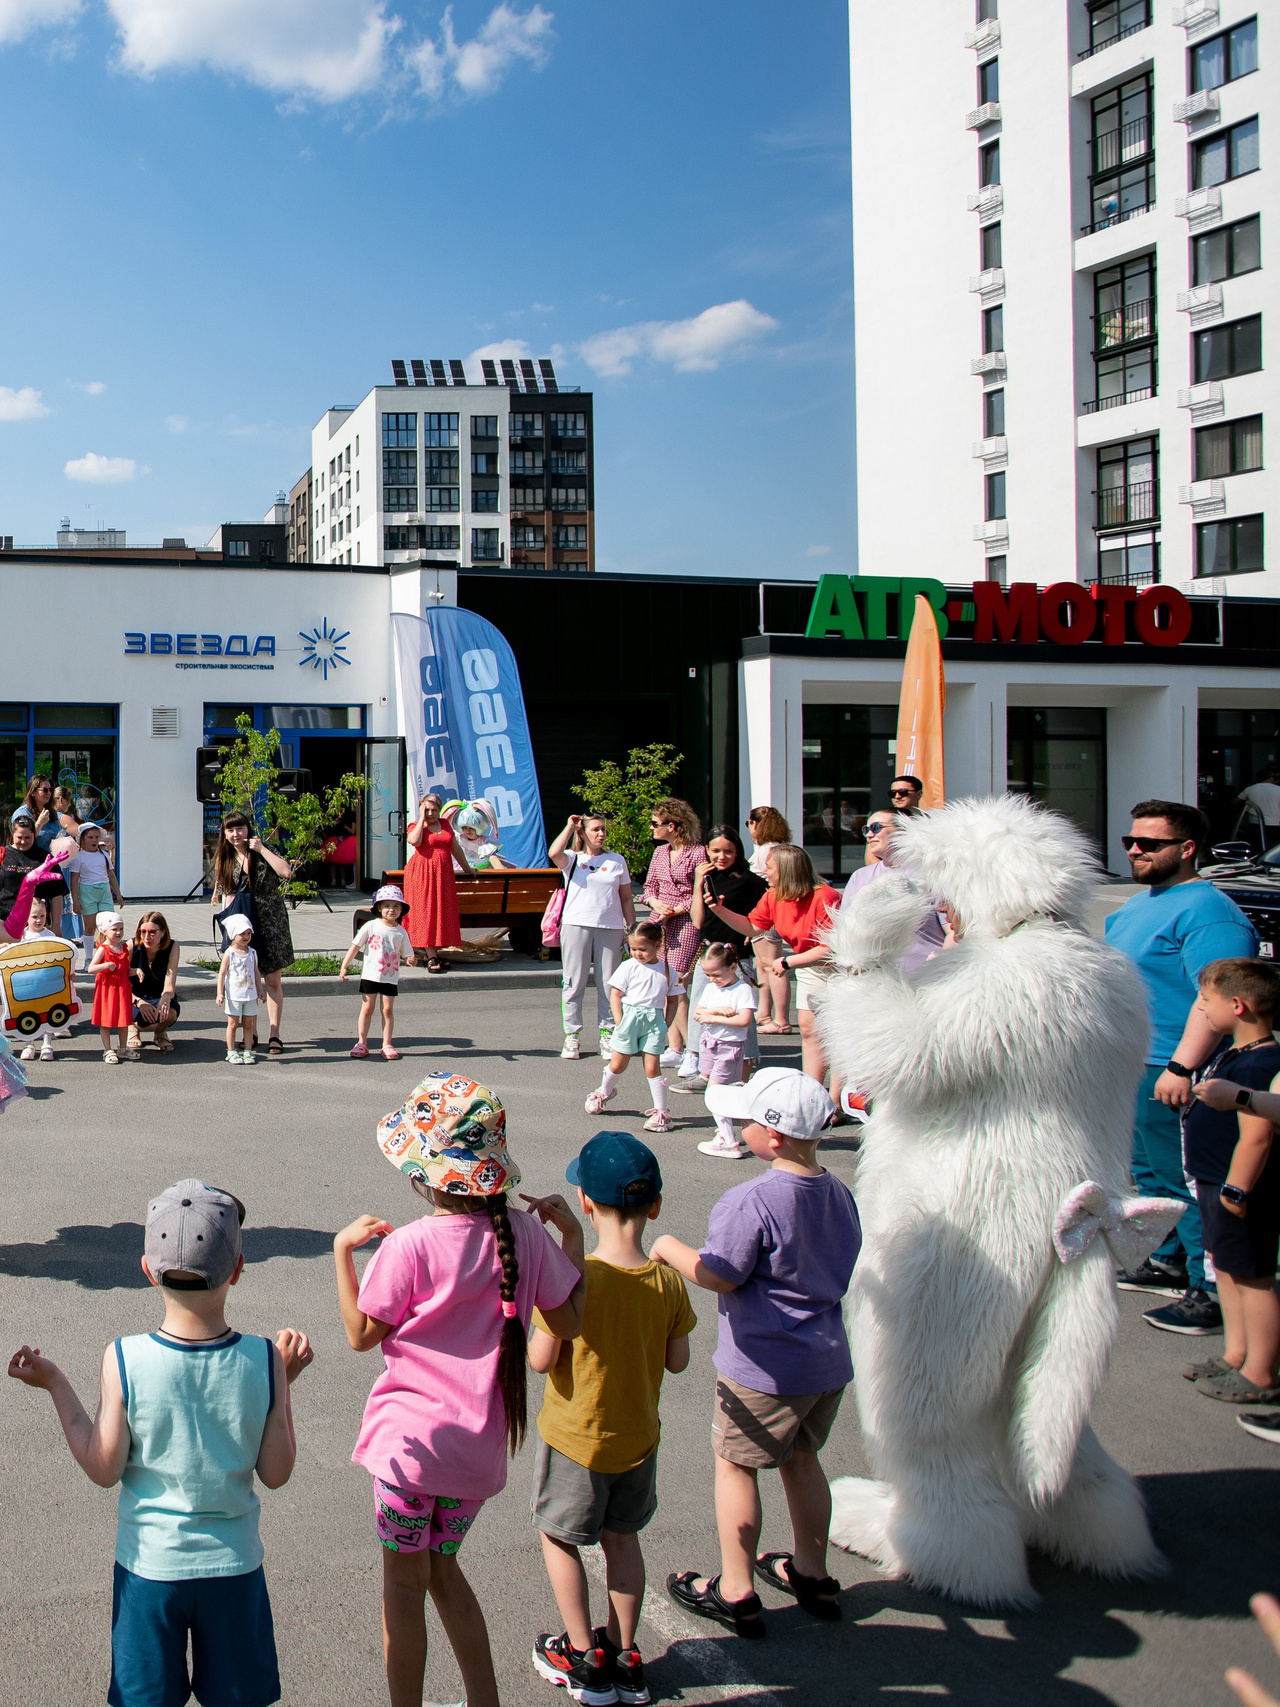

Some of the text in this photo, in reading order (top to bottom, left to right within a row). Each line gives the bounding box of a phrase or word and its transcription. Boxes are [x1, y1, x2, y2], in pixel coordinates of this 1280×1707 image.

[123, 632, 276, 656] ЗВЕЗДА
[175, 662, 275, 671] строительная экосистема
